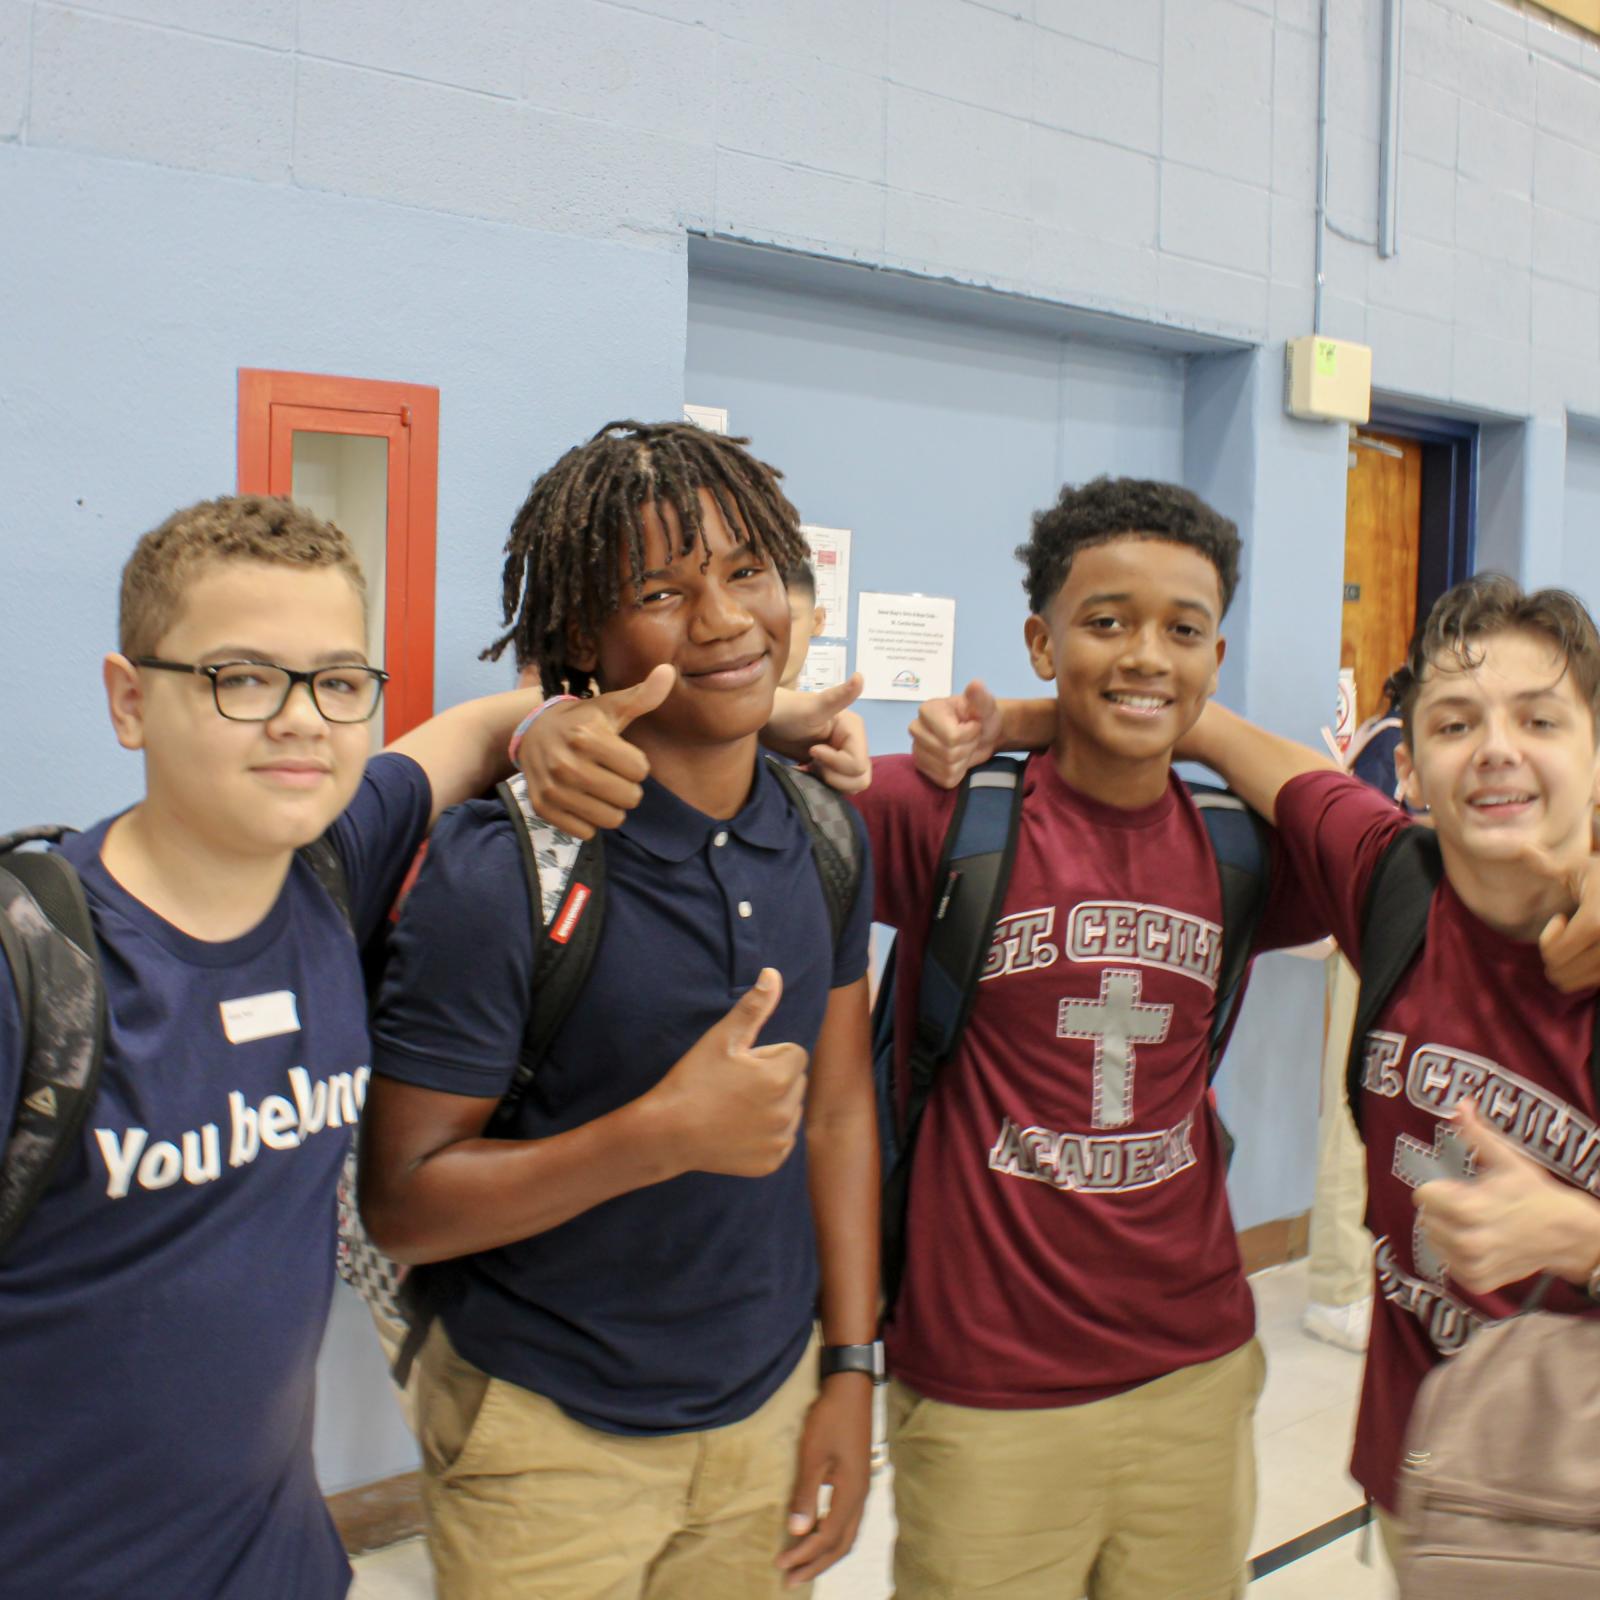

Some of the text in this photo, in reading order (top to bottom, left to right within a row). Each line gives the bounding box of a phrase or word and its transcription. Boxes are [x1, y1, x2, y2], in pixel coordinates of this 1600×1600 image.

[1066, 900, 1223, 991] CECILI
[1362, 1030, 1407, 1097] T.
[94, 1122, 221, 1199] You
